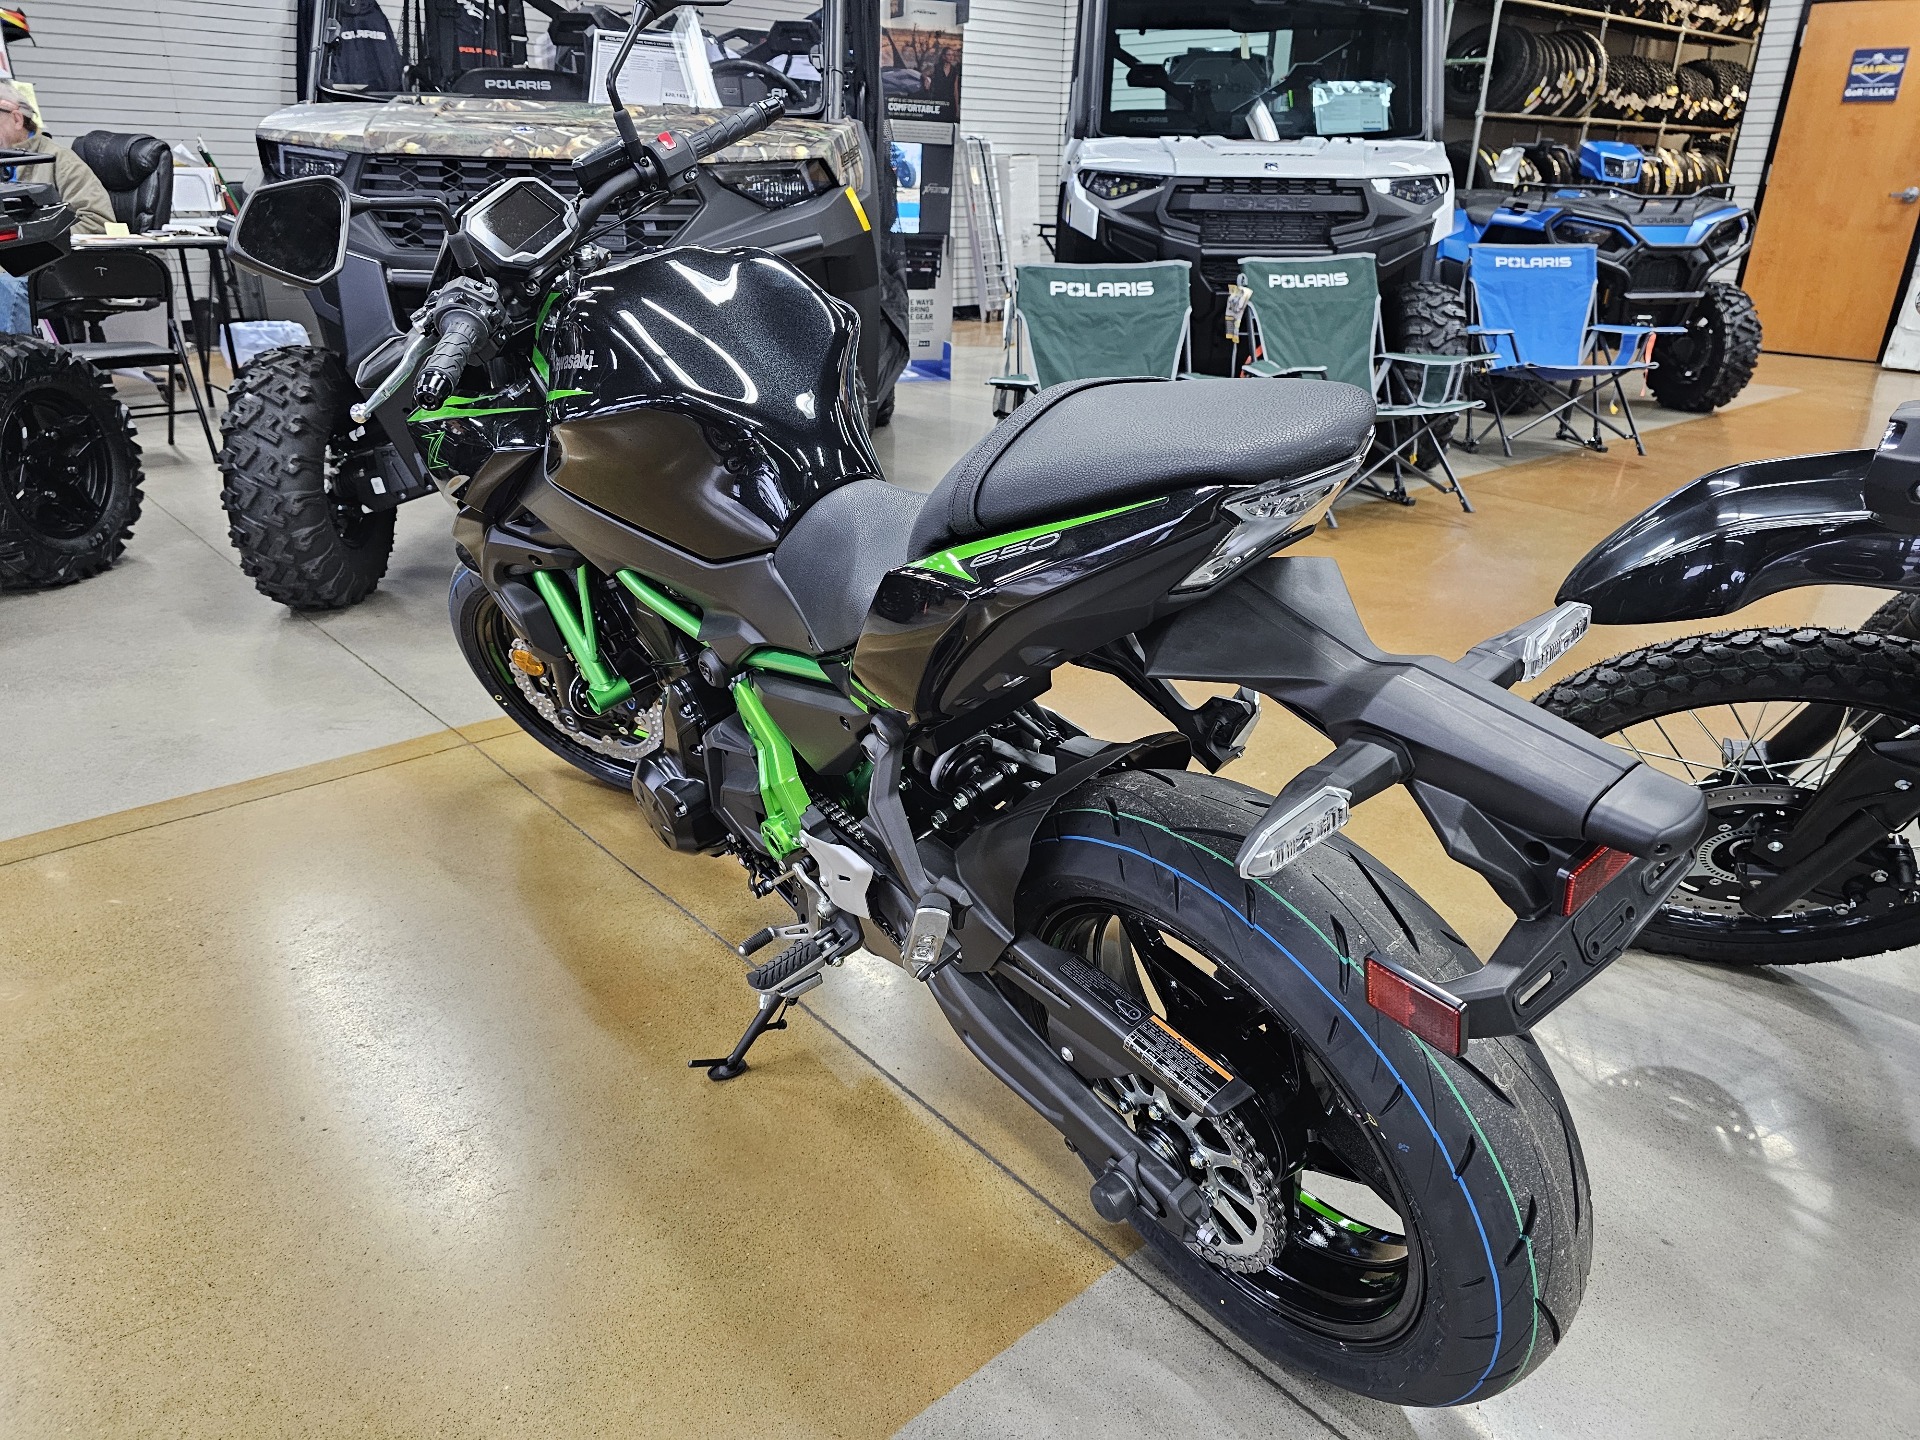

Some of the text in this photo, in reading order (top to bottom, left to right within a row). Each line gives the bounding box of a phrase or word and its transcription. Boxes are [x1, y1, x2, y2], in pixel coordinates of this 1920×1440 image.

[341, 29, 387, 40] OLARIS
[484, 79, 552, 91] POLARIS
[888, 103, 941, 114] COMFORTABLE
[1129, 115, 1168, 123] POLARIS
[1223, 196, 1313, 211] POLARIS
[1495, 256, 1572, 268] POLARIS
[1268, 271, 1349, 289] POLARIS
[1049, 280, 1155, 298] POLARIS
[970, 532, 1062, 568] 650
[1181, 1039, 1204, 1058] WARNING
